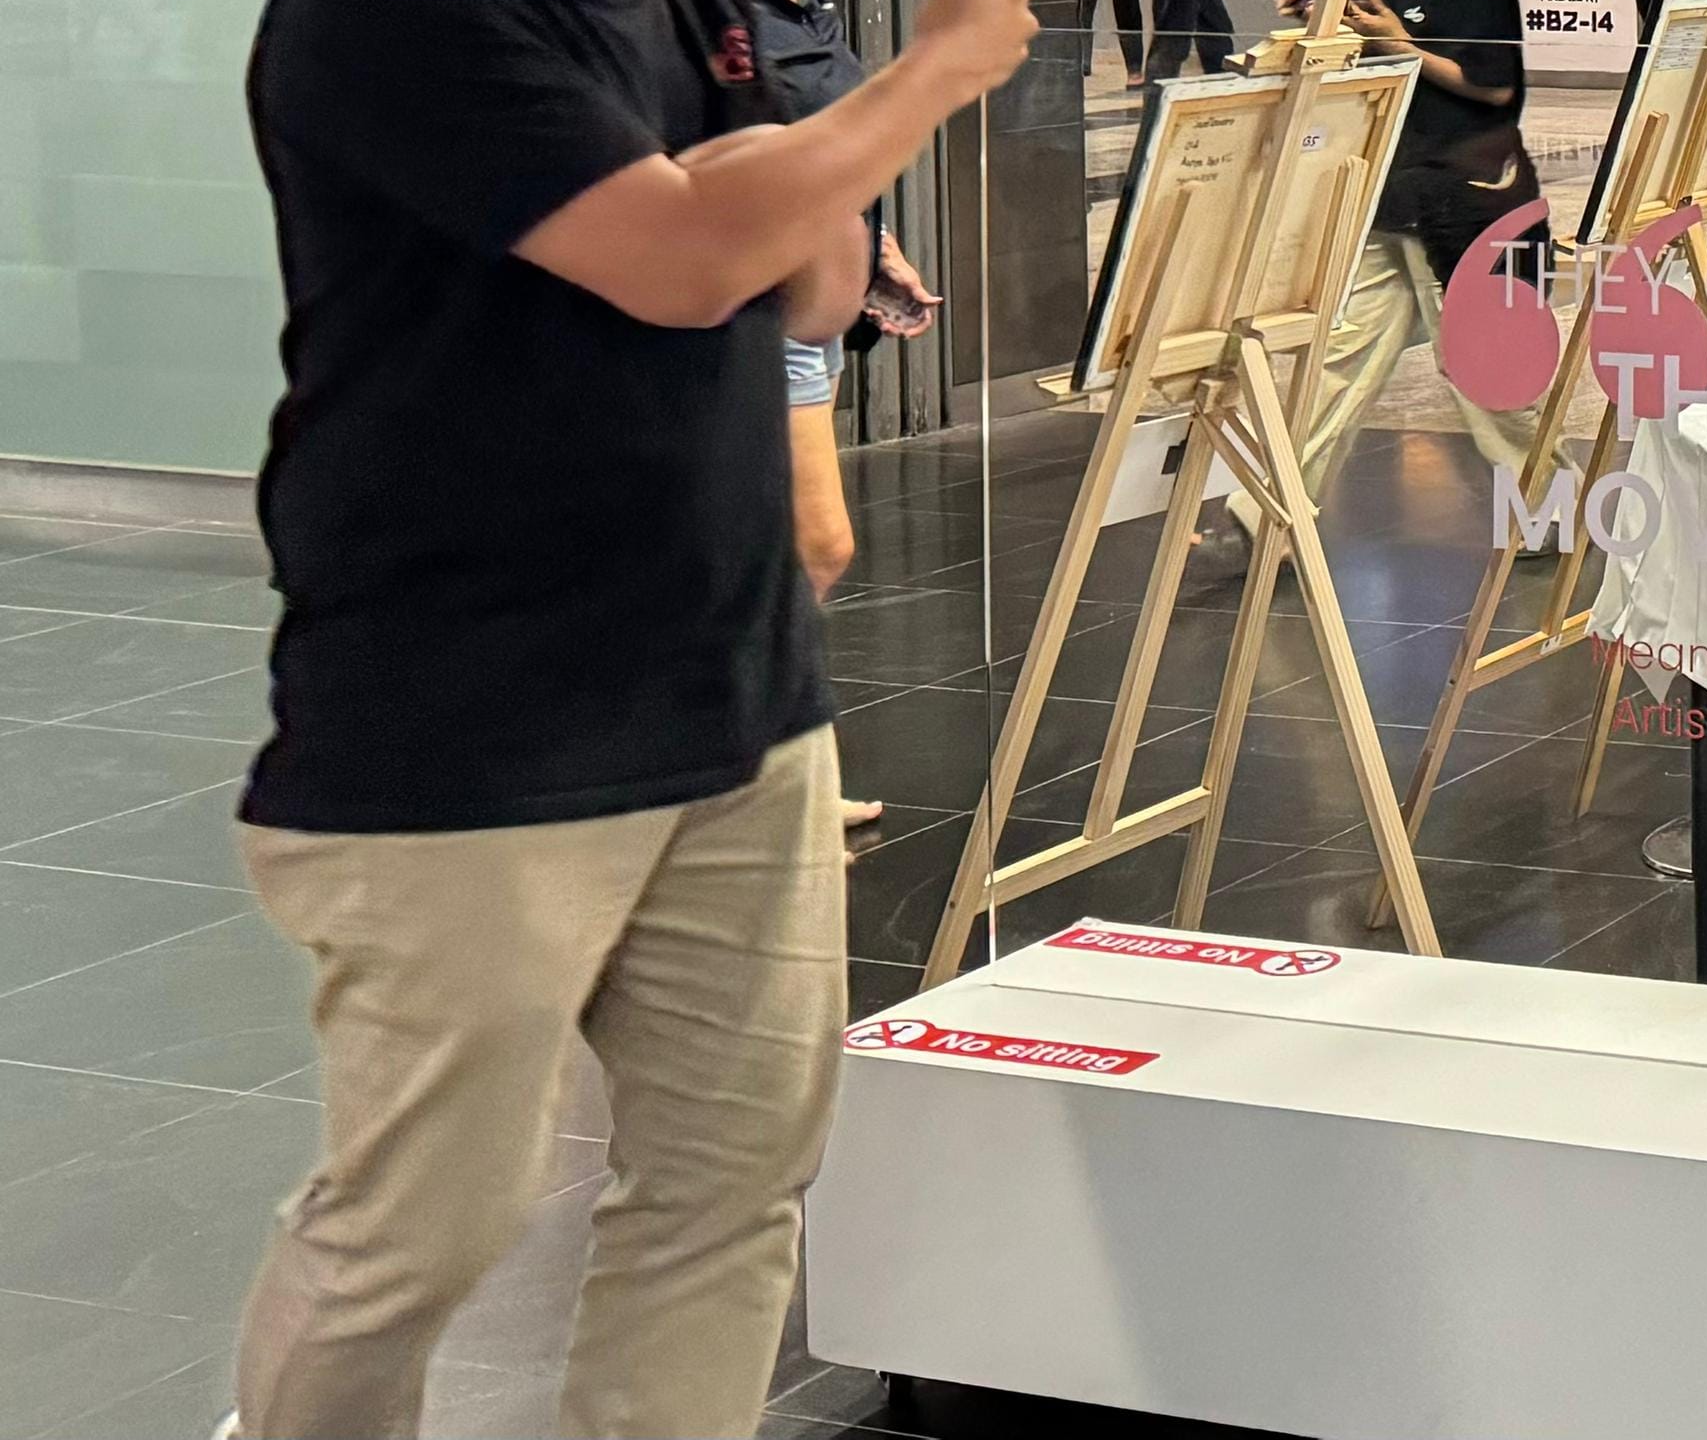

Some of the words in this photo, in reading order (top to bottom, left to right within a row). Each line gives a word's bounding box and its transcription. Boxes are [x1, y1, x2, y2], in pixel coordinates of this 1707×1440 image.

[1526, 9, 1614, 33] #B2-14
[1490, 240, 1677, 317] THEY
[930, 1031, 992, 1054] No
[995, 1040, 1128, 1072] sitting
